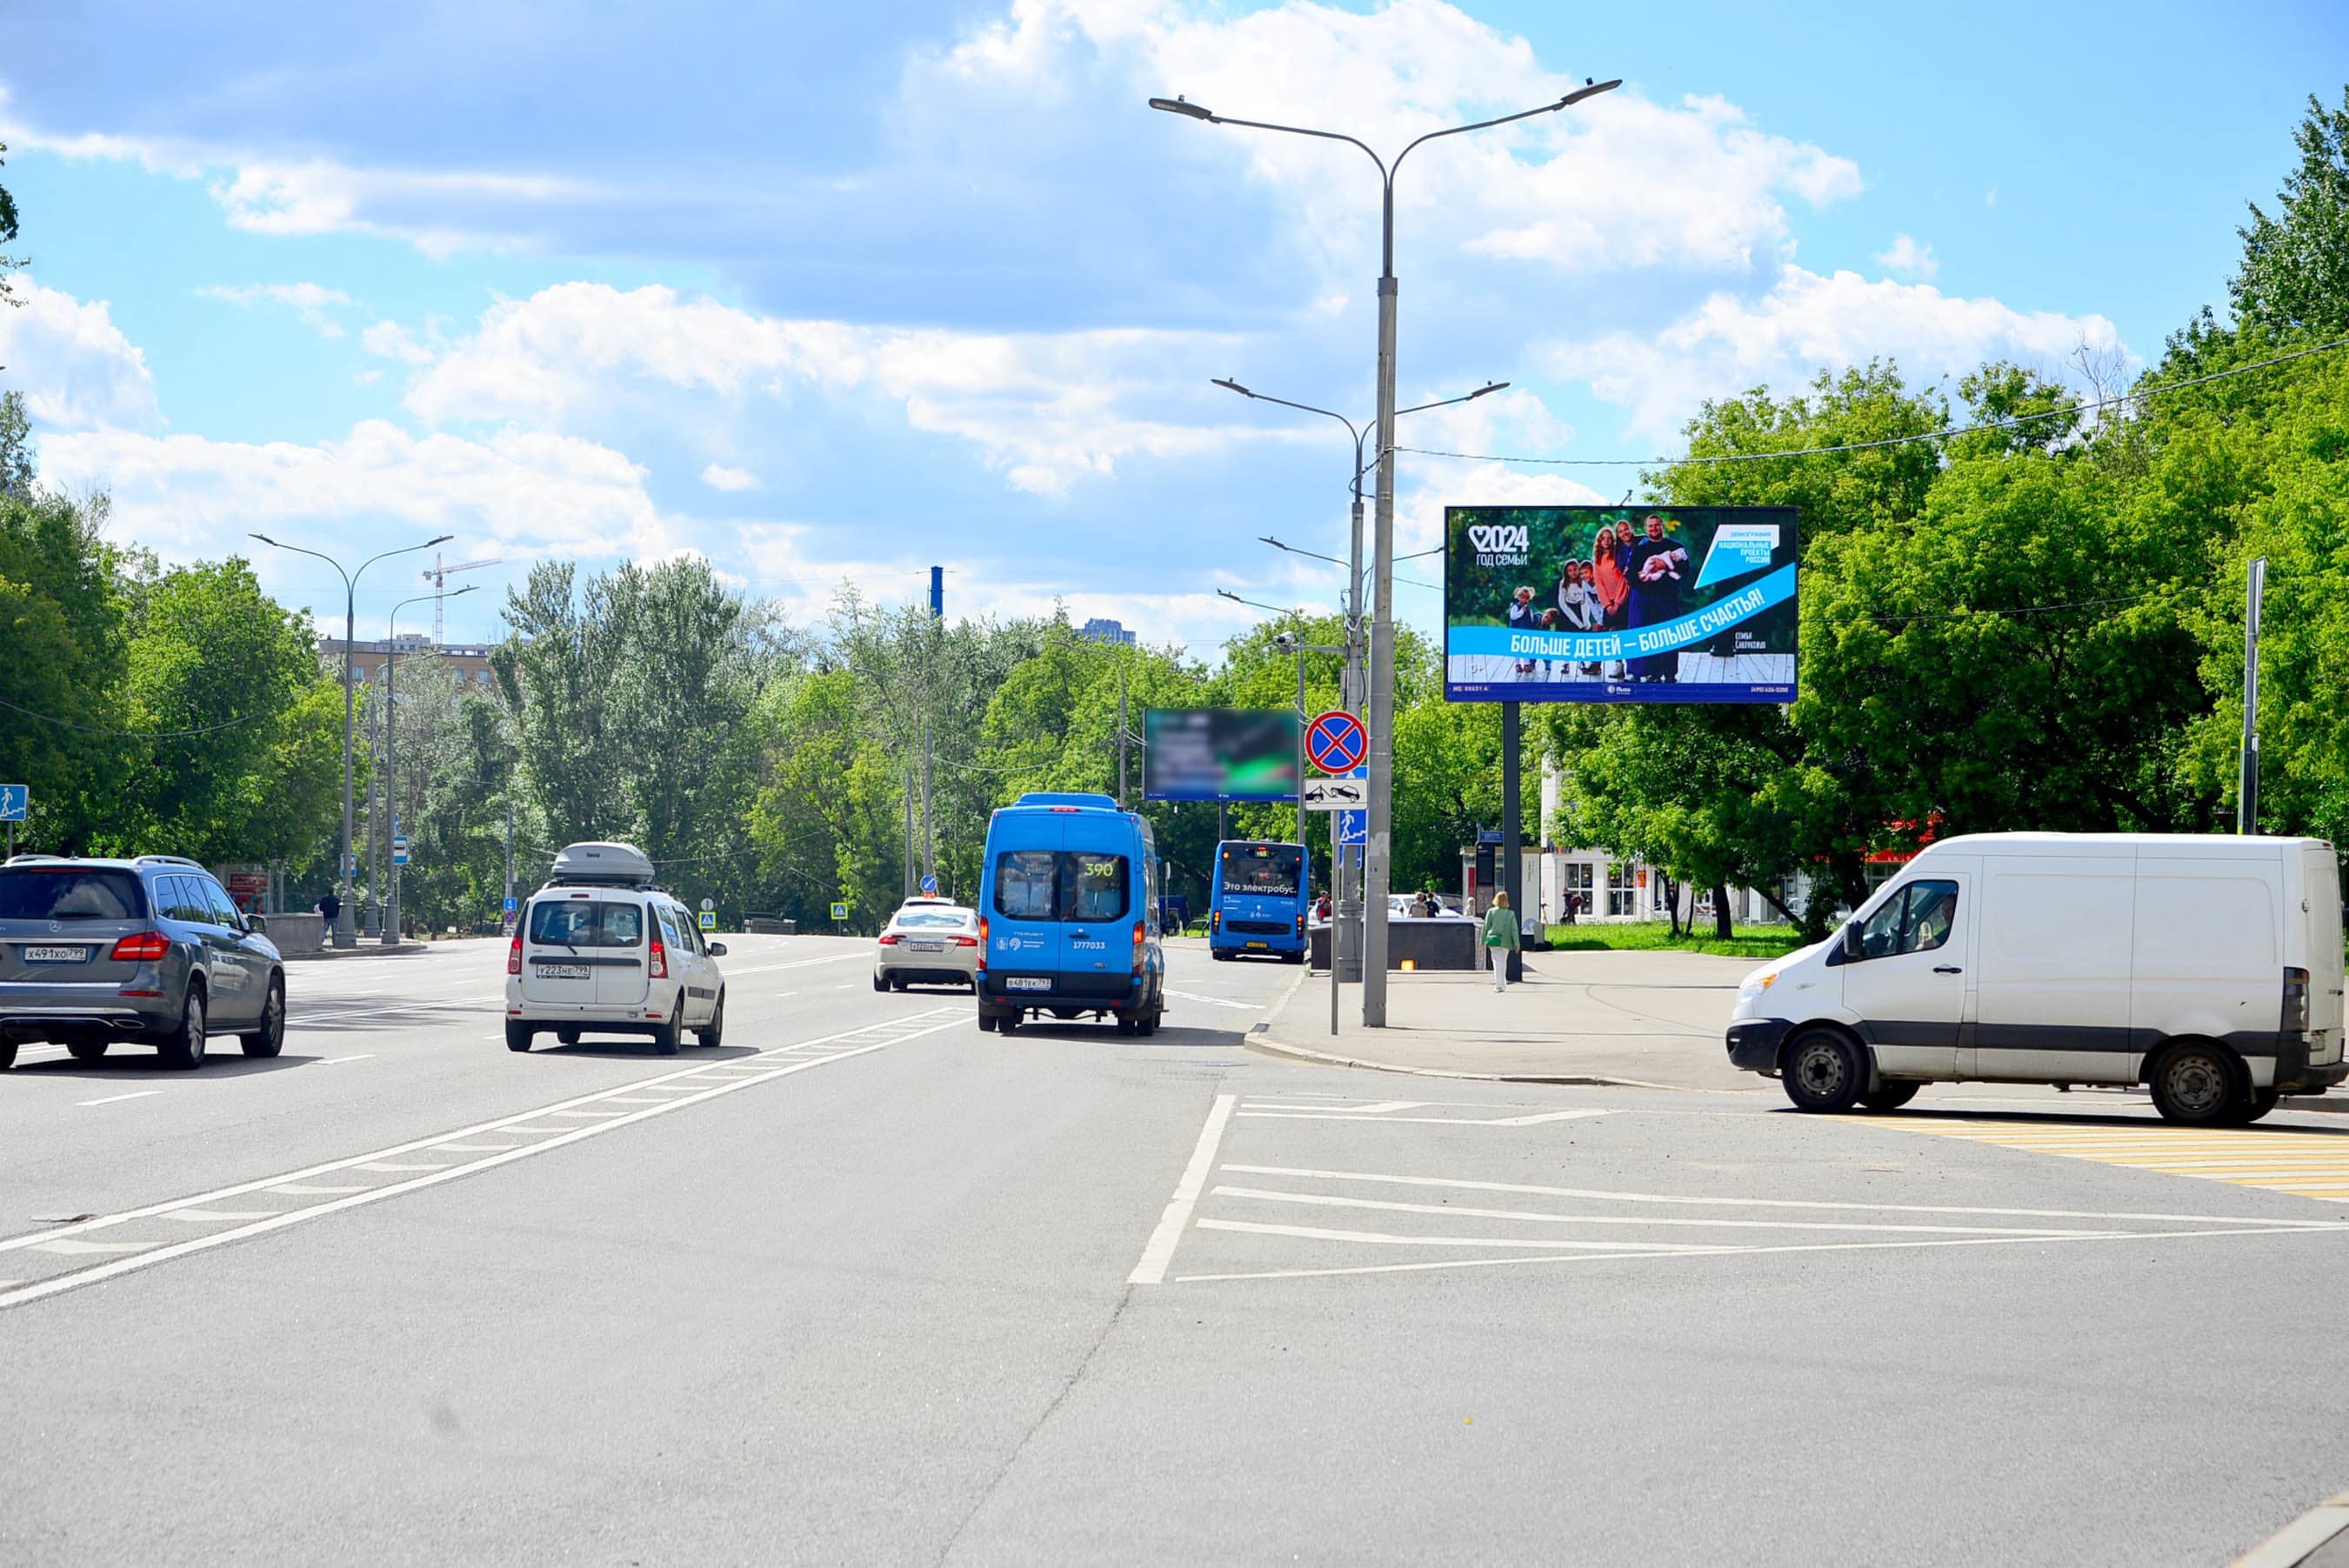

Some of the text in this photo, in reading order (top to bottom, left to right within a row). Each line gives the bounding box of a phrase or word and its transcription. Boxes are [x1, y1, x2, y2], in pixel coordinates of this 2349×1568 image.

[1468, 525, 1530, 553] 2024
[1511, 634, 1571, 657] БОЛЬШЕ
[1573, 634, 1622, 659] ДЕТЕЙ
[1638, 621, 1700, 652] БОЛЬШЕ
[1699, 588, 1765, 633] СЧАСТЬЯ!
[1084, 863, 1114, 877] 390
[1224, 881, 1297, 895] Это электробус.
[1073, 941, 1106, 950] 1777033
